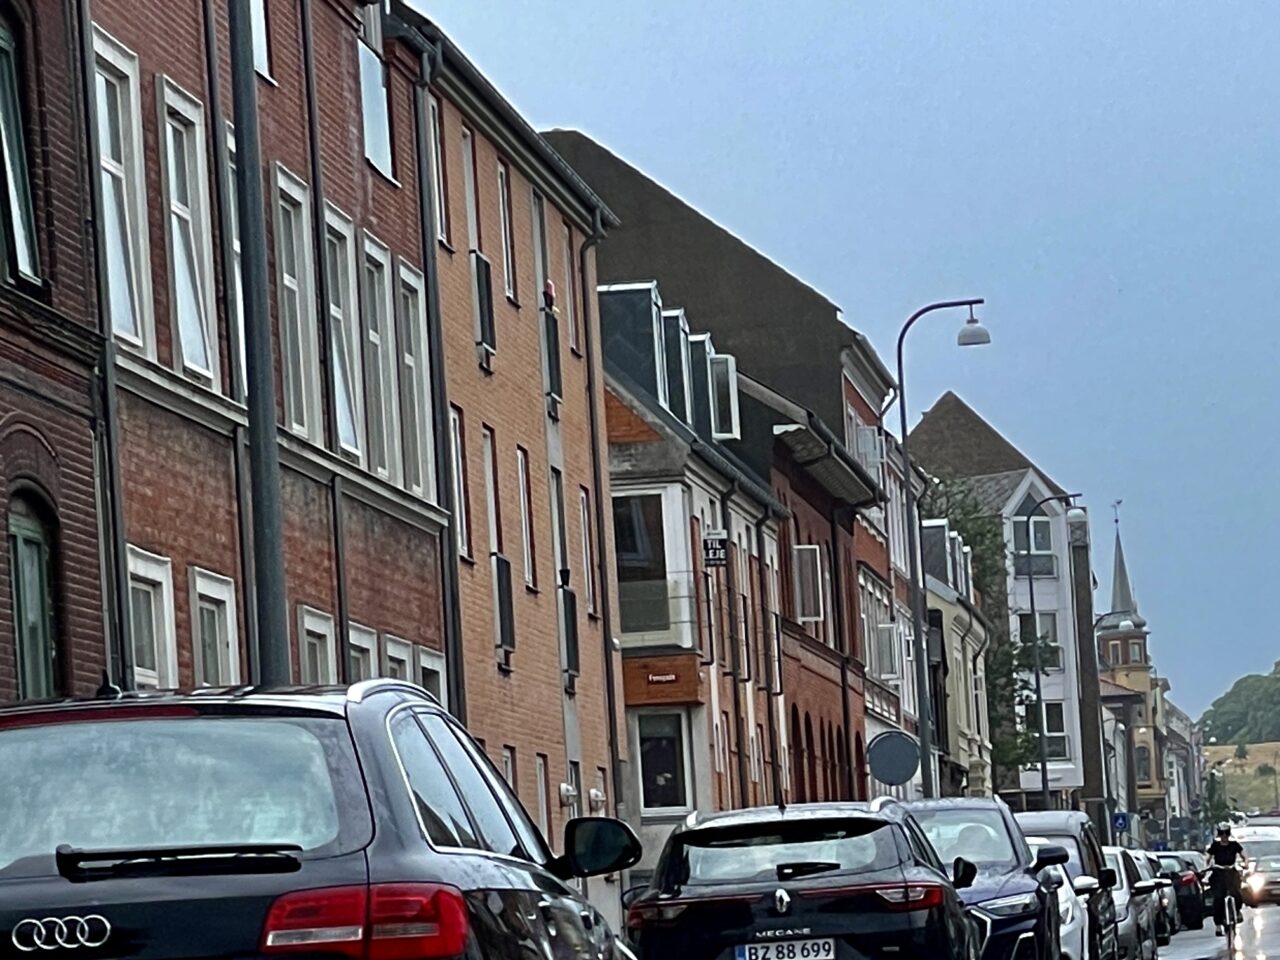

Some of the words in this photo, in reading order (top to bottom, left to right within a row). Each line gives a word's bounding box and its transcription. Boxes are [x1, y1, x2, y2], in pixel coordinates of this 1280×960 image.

[706, 539, 722, 549] TIL
[775, 943, 797, 960] 88
[801, 940, 832, 958] 699
